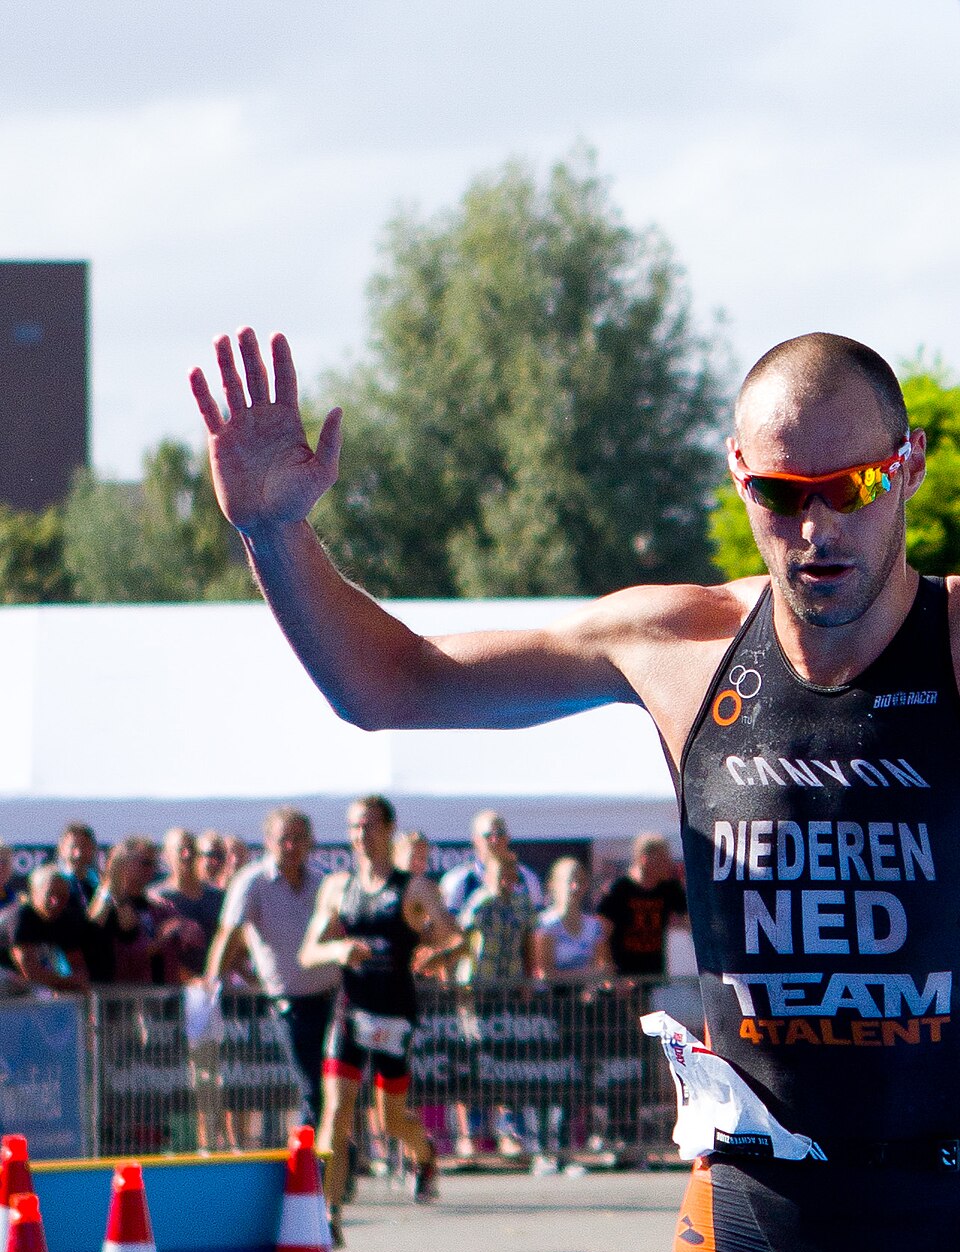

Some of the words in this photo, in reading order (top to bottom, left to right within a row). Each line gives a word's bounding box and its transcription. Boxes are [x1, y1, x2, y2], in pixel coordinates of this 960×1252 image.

[726, 755, 931, 788] CANYON
[713, 820, 936, 882] DIEDEREN
[743, 889, 908, 955] NED
[722, 971, 952, 1018] TEAM
[739, 1017, 951, 1047] 4TALENT
